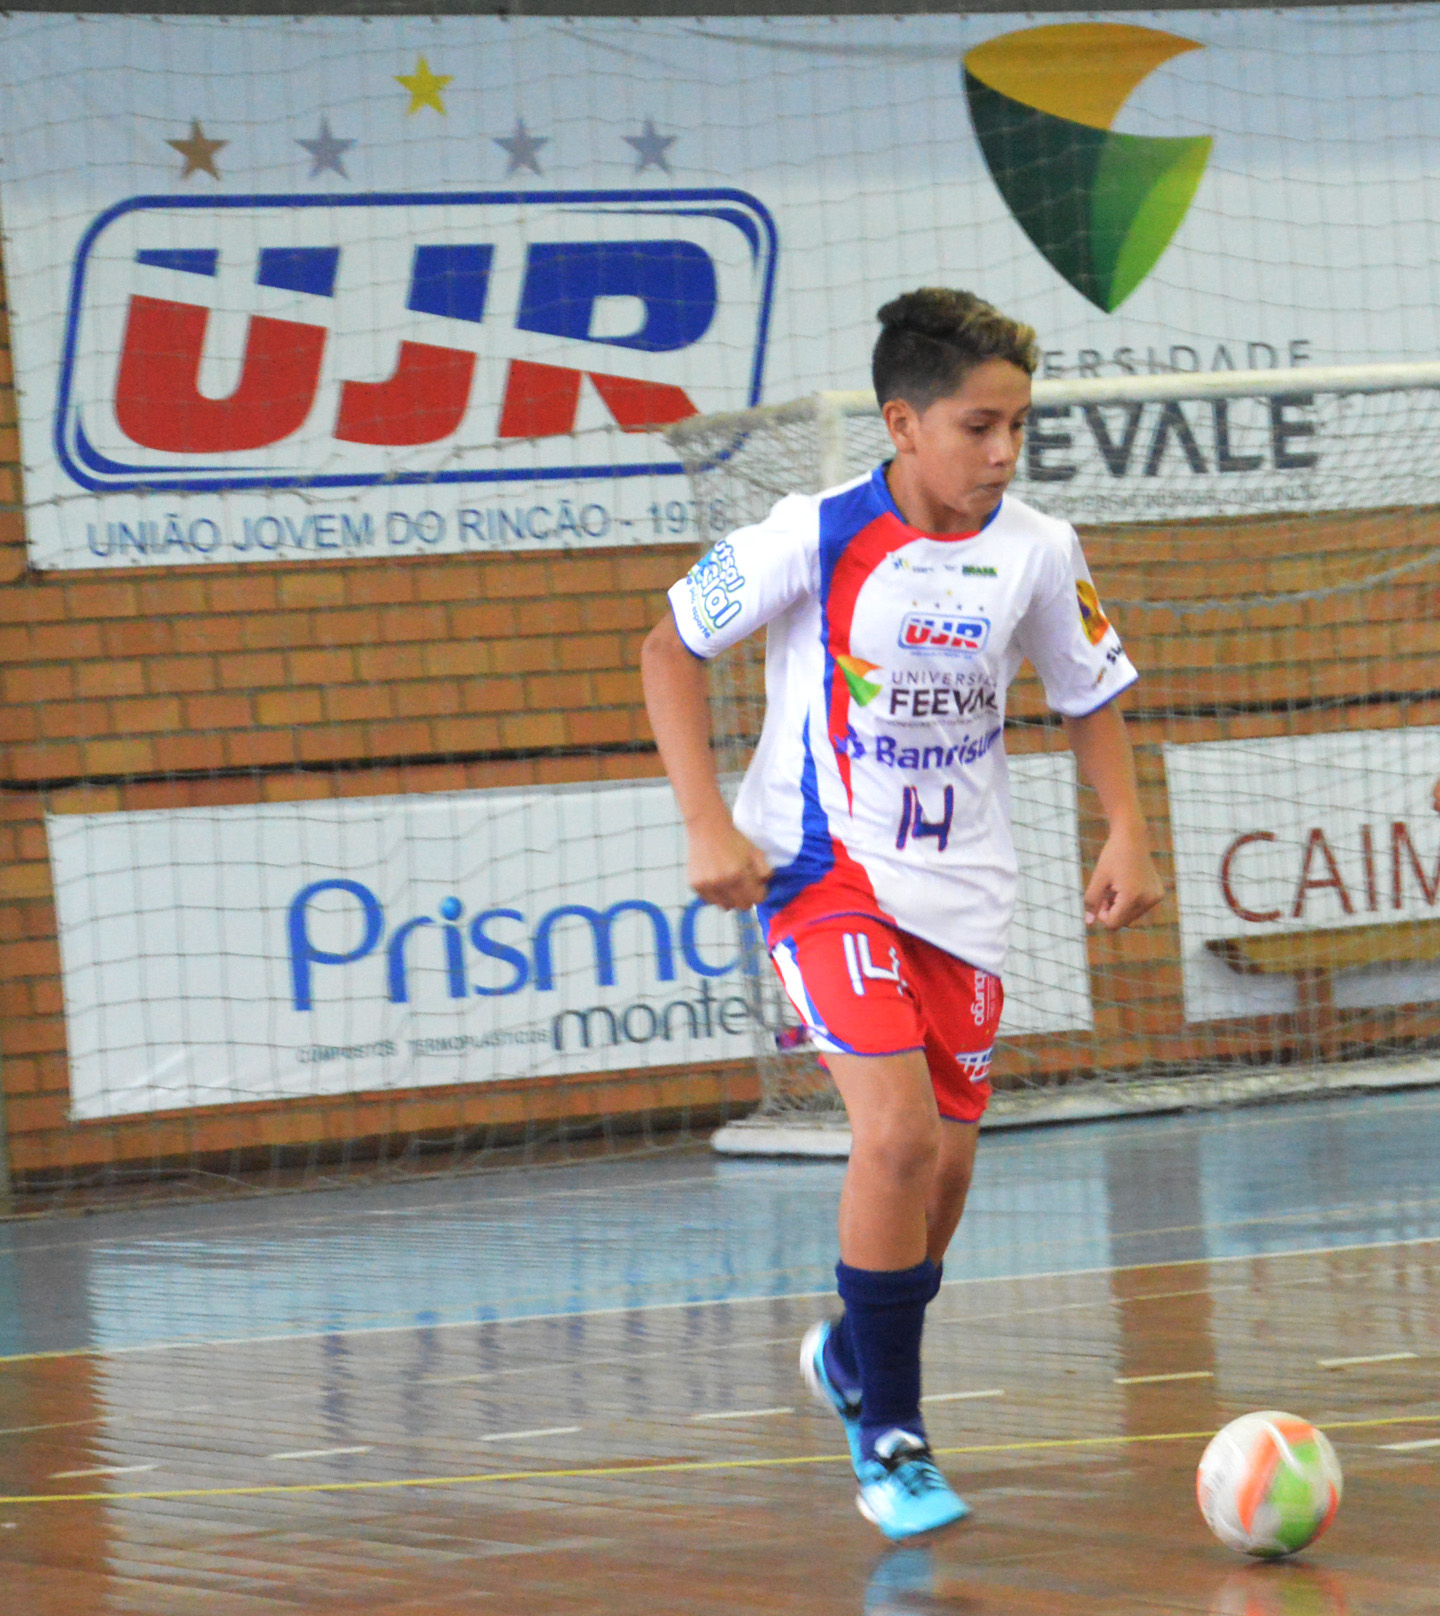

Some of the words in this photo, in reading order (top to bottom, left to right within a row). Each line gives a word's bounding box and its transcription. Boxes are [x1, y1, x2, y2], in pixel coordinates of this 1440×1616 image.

[113, 239, 717, 453] UJR
[1043, 340, 1312, 379] ERSIDADE
[1027, 393, 1318, 482] EVALE
[87, 513, 222, 557] UNIÃO
[232, 511, 377, 553] JOVEM
[385, 506, 443, 545] DO
[456, 500, 610, 542] RINCÃO
[905, 617, 983, 649] UJR
[897, 784, 954, 852] 14
